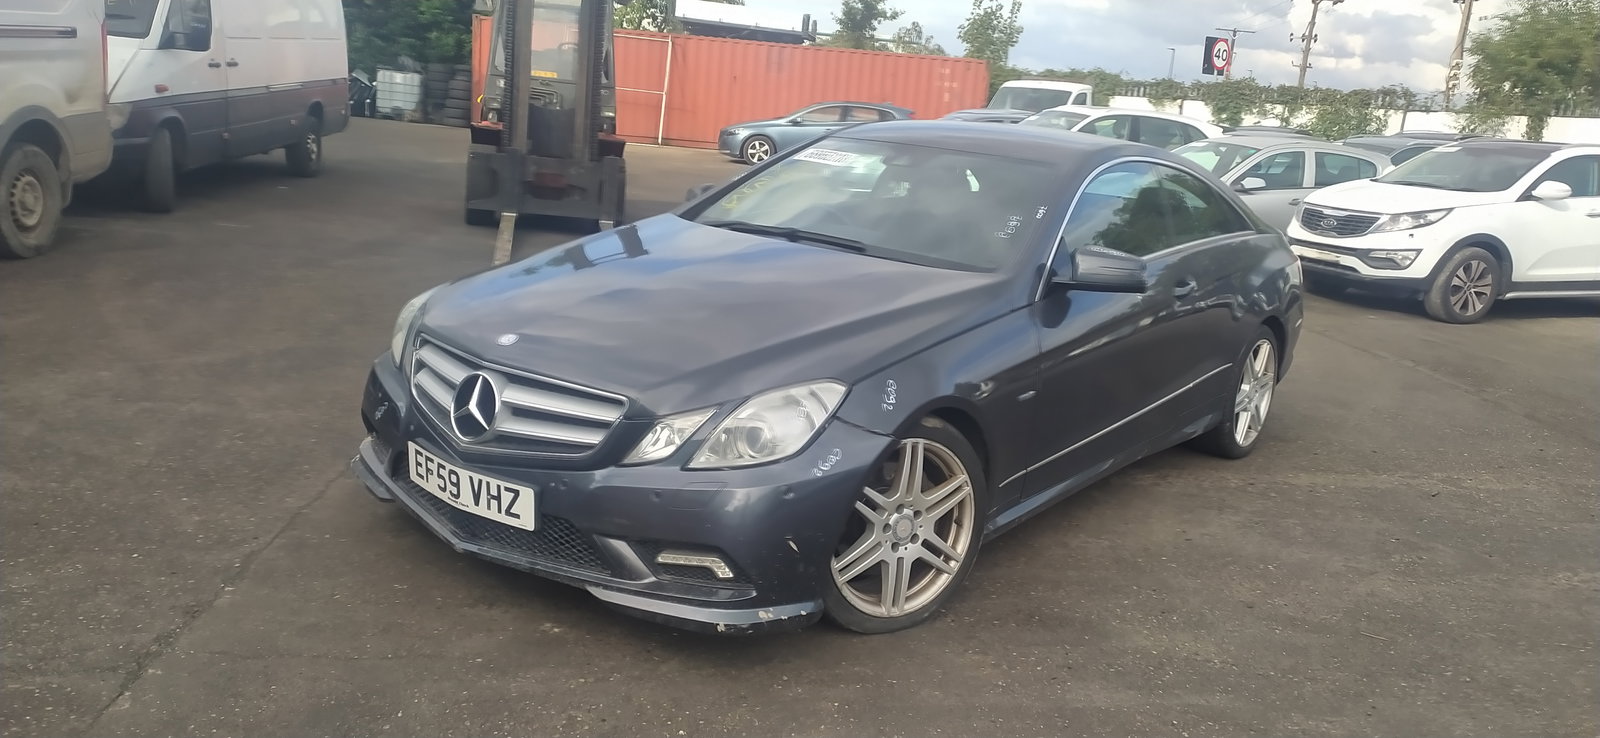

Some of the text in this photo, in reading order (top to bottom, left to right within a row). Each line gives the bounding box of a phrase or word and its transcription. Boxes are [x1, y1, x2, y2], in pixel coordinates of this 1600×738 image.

[1214, 48, 1228, 62] 40
[414, 447, 521, 521] EF59 VHZ
